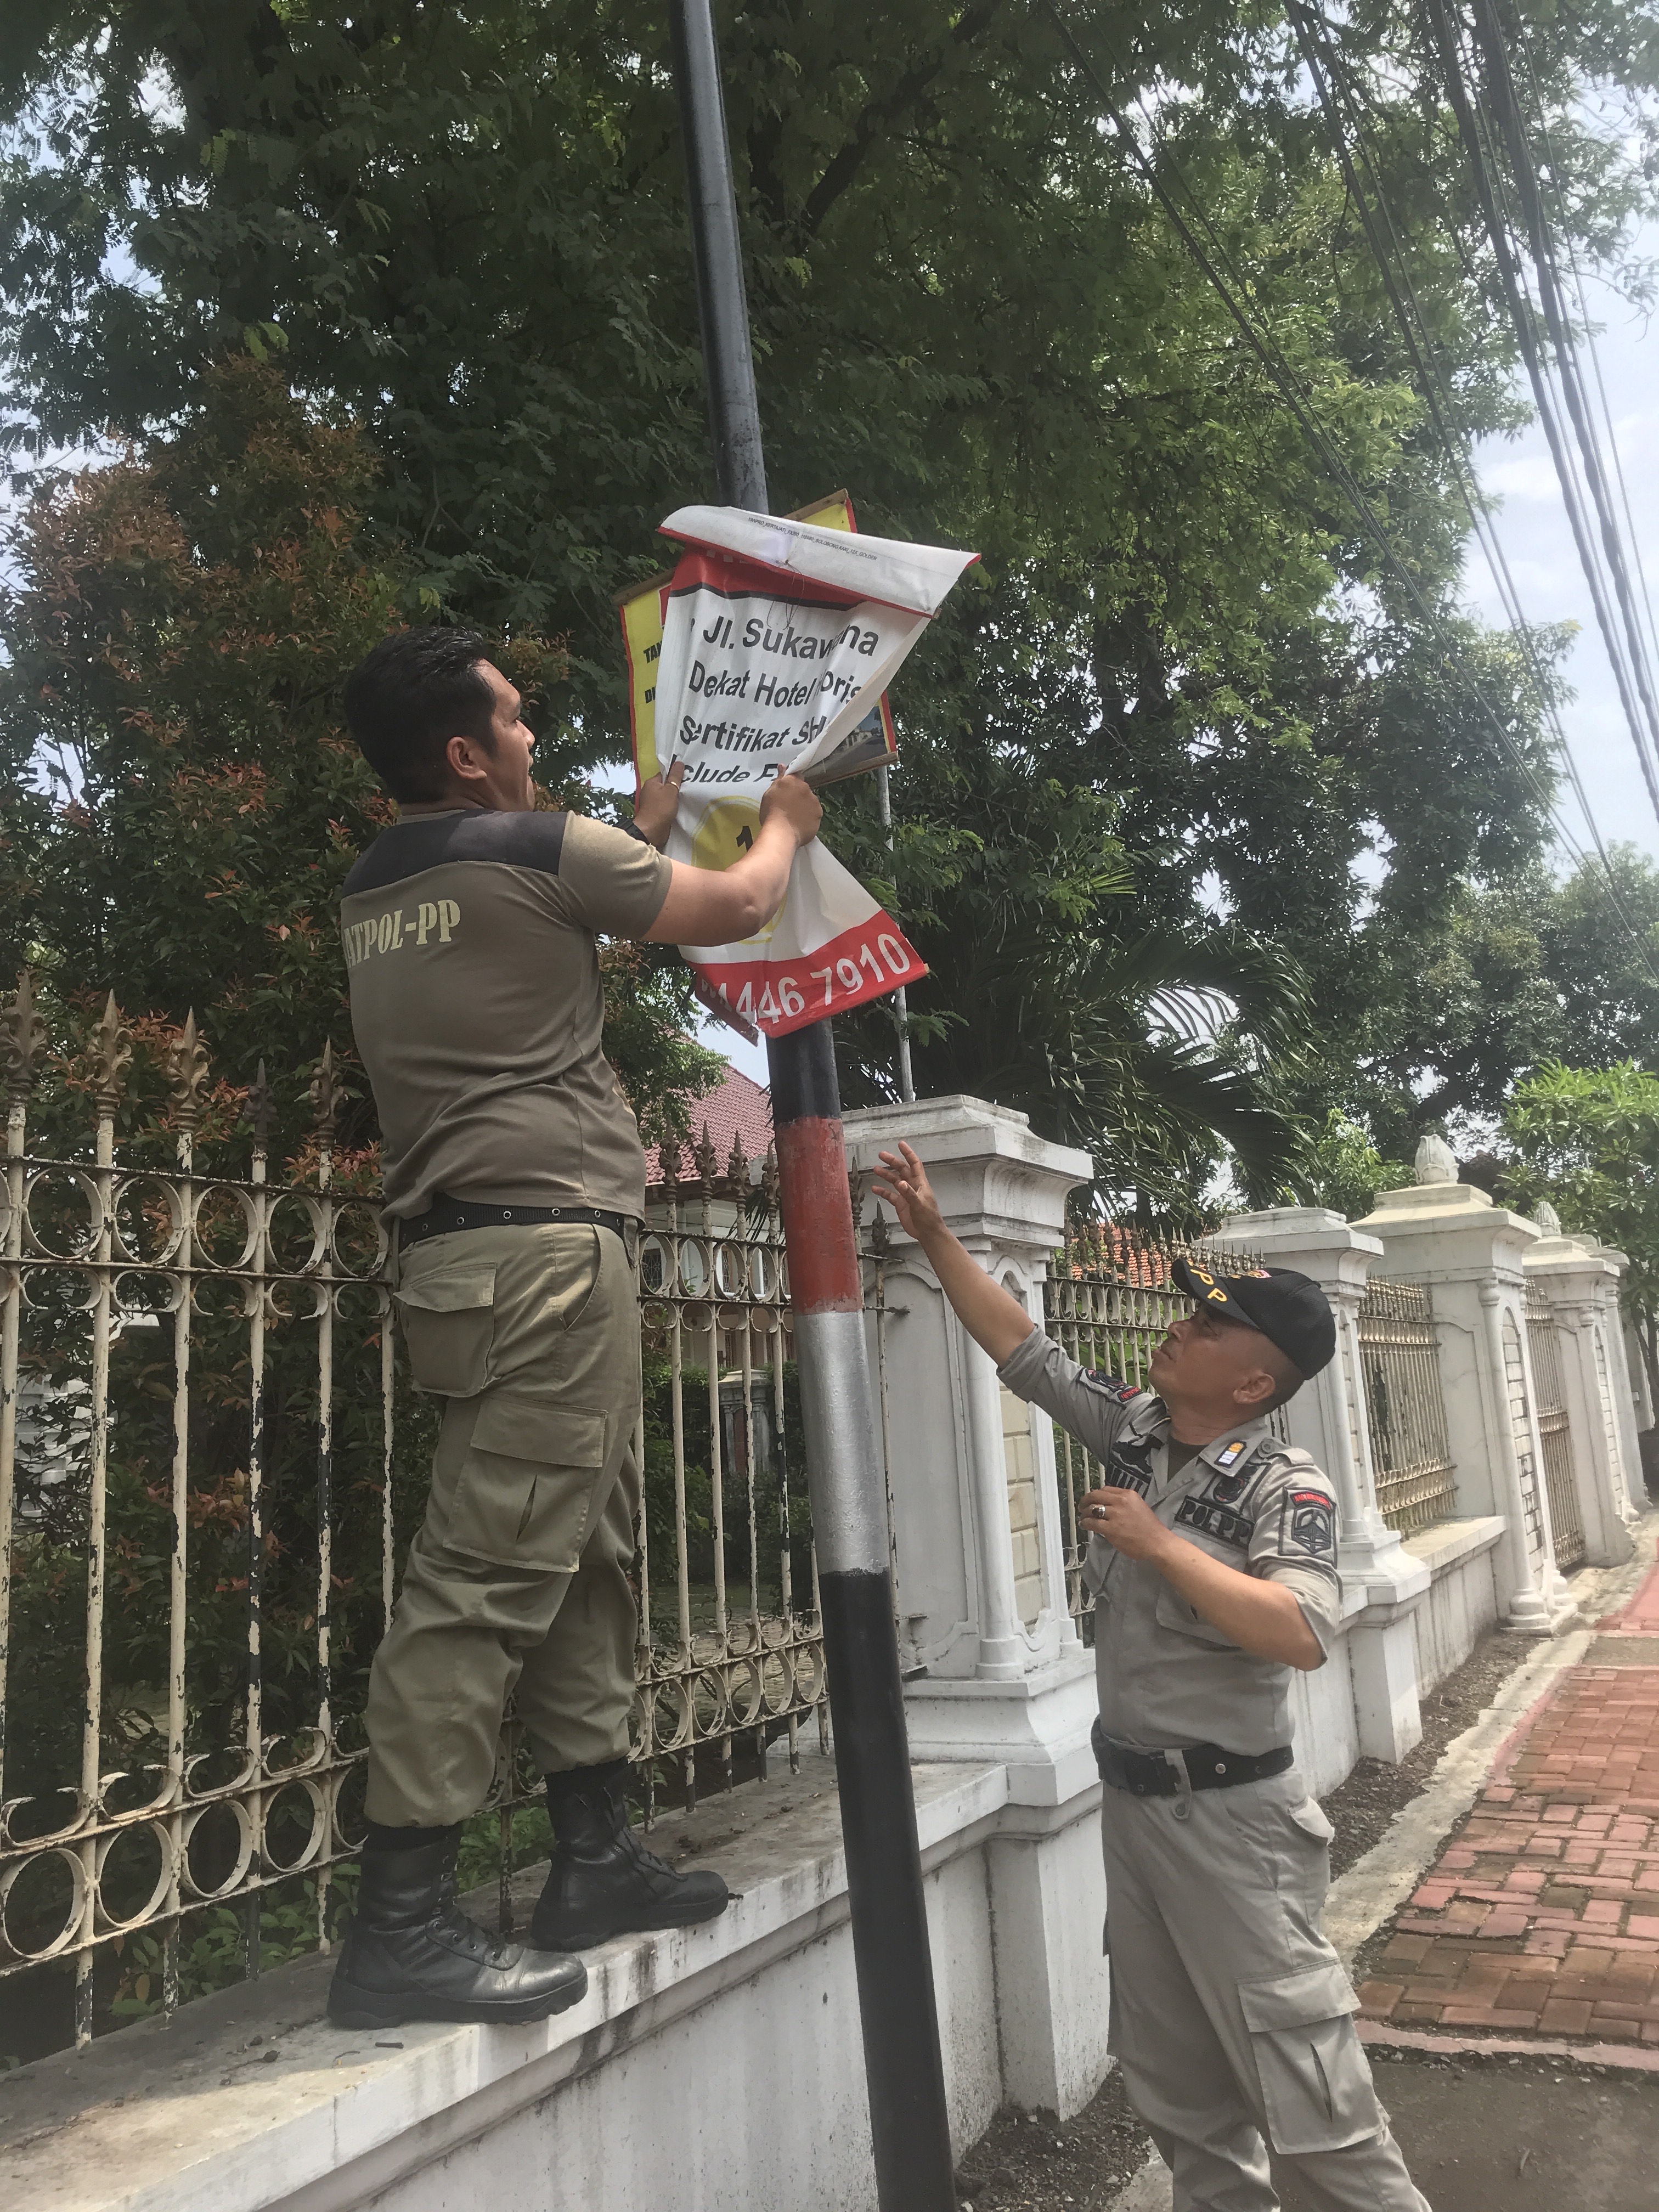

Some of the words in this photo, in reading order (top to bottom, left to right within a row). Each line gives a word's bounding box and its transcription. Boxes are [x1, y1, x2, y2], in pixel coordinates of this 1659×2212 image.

[703, 616, 735, 650] Jl.
[689, 660, 751, 698] Dekat
[754, 672, 817, 708] Hotel
[680, 715, 791, 752] Sertifikat
[792, 715, 828, 746] SH
[667, 754, 751, 783] Iclude
[343, 899, 461, 969] ATPOL-PP
[810, 933, 911, 1007] 7910
